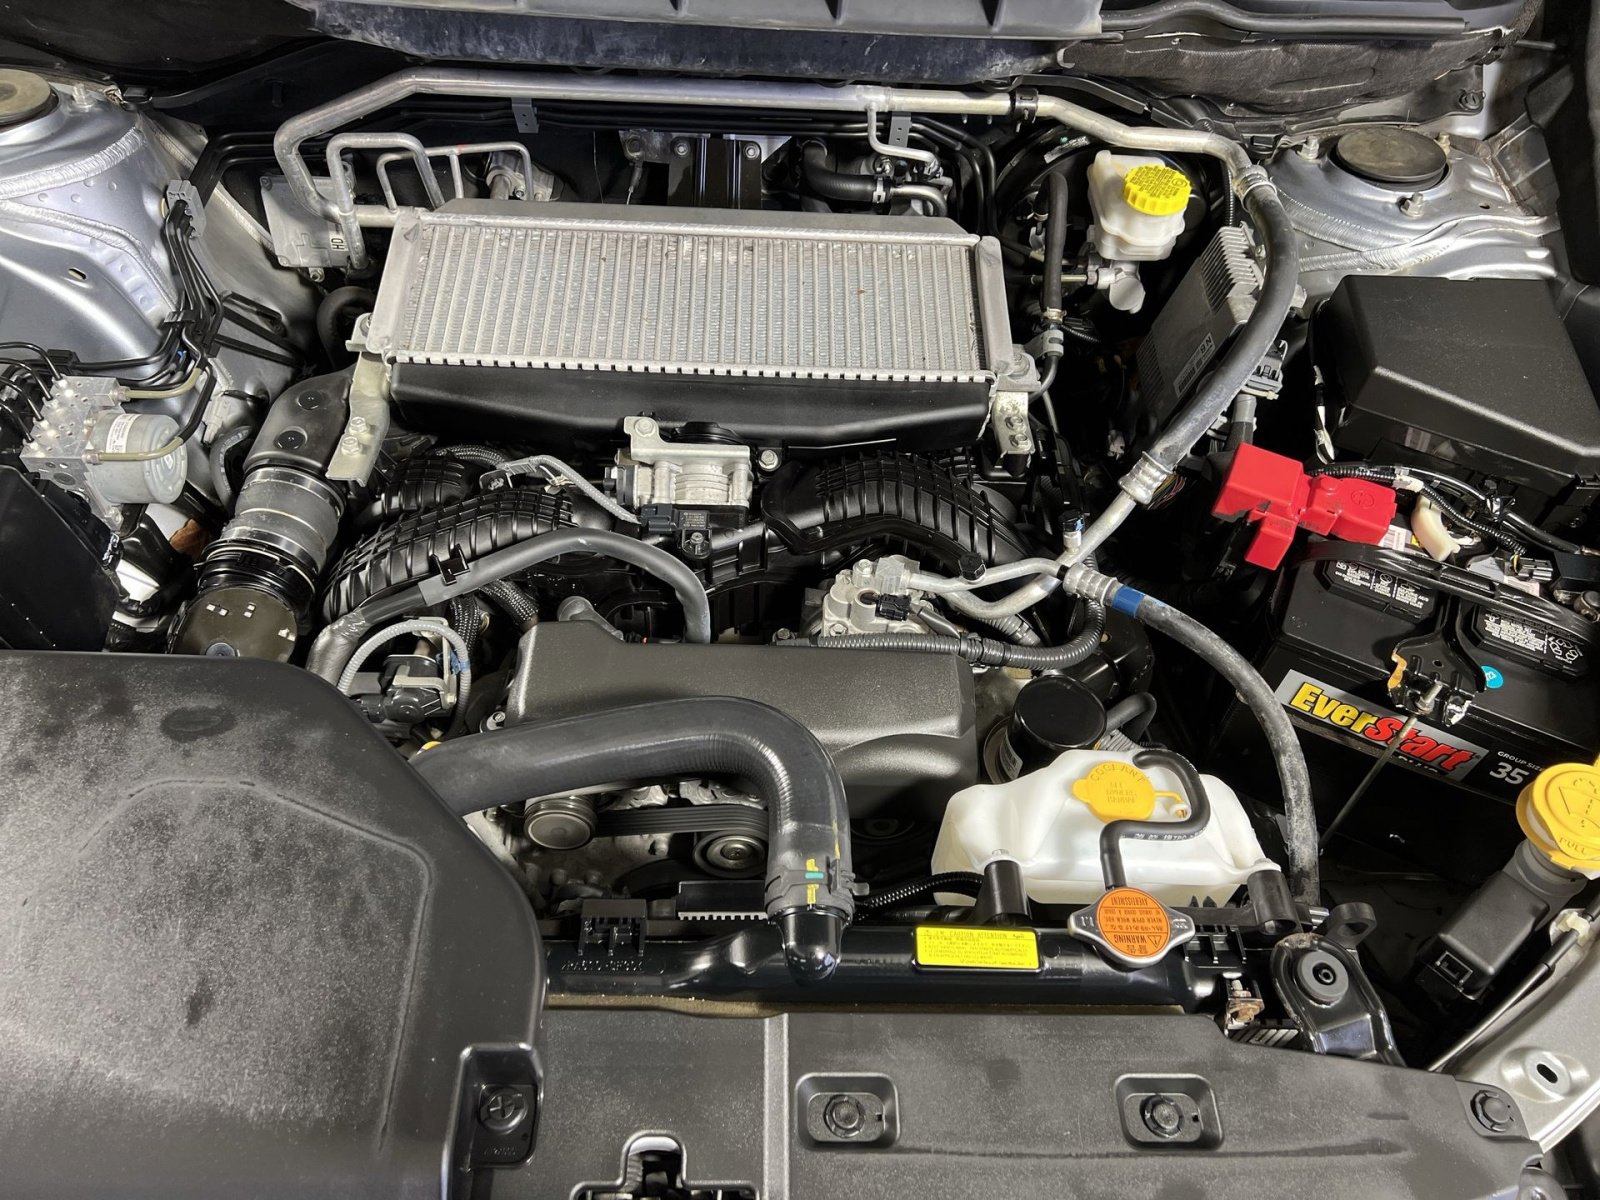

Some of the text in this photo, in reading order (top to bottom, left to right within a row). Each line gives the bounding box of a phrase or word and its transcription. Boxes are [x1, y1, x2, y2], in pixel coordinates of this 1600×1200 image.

[1289, 681, 1475, 772] EverStart
[1497, 750, 1527, 765] GROUP
[1489, 761, 1530, 785] 35
[1559, 836, 1588, 856] PULL
[1113, 934, 1147, 944] WARNING
